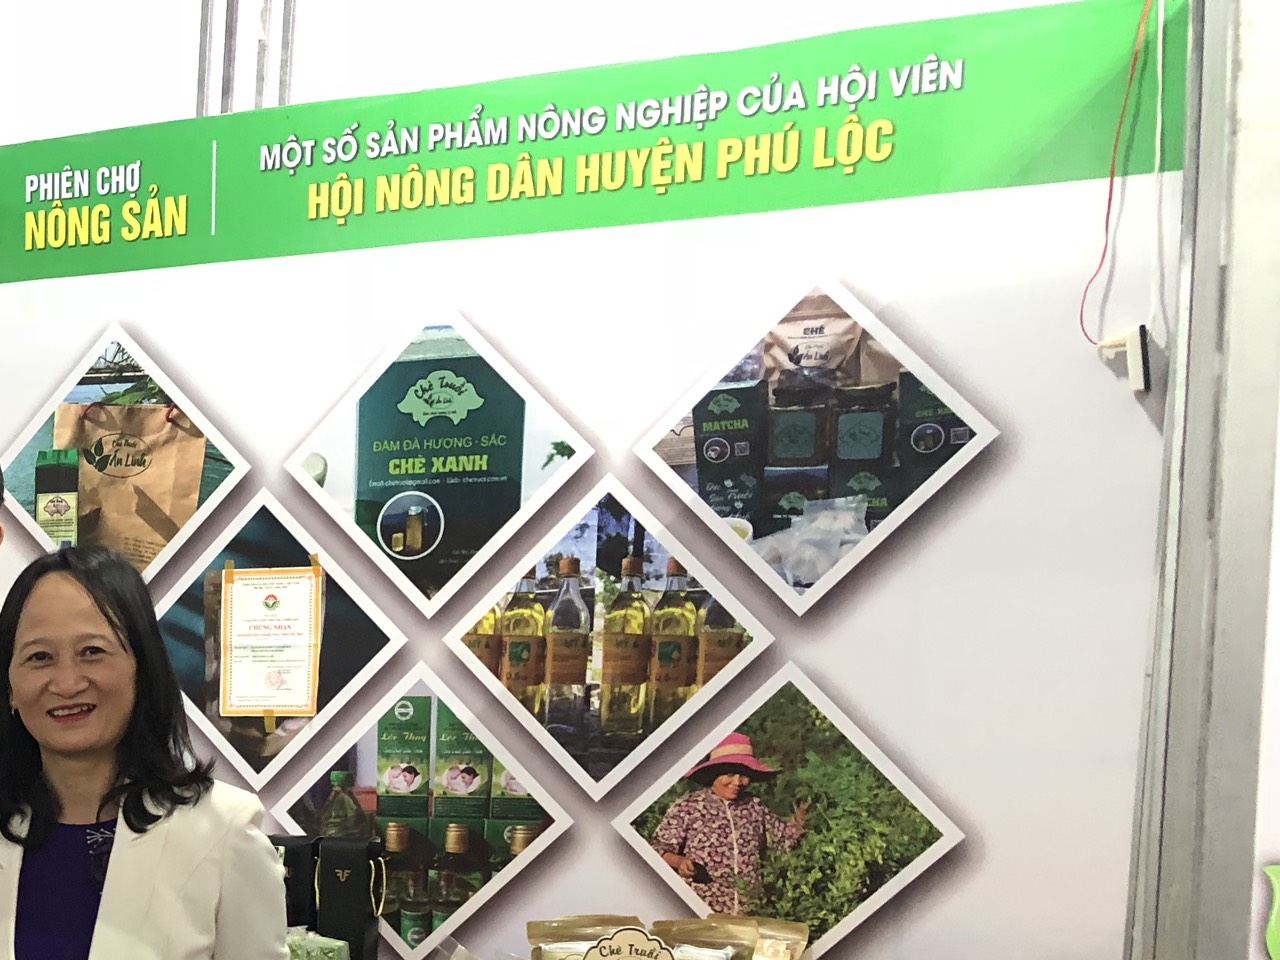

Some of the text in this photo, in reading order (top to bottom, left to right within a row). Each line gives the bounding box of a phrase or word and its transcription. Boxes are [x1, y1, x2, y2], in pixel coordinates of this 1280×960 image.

[260, 53, 964, 175] MỘT SỐ SẢN PHẨM NÔNG NGHIỆP CỦA HỘI VIÊN
[25, 160, 142, 203] PHIÊN CHỢ
[308, 113, 894, 226] HỘI NÔNG DÂN HUYỆN PHÚ LỘC
[24, 184, 187, 251] NÔNG SẢN
[702, 418, 750, 433] MATCHA
[388, 454, 489, 475] CHÈ XANH
[599, 944, 662, 960] Chè Truồi
